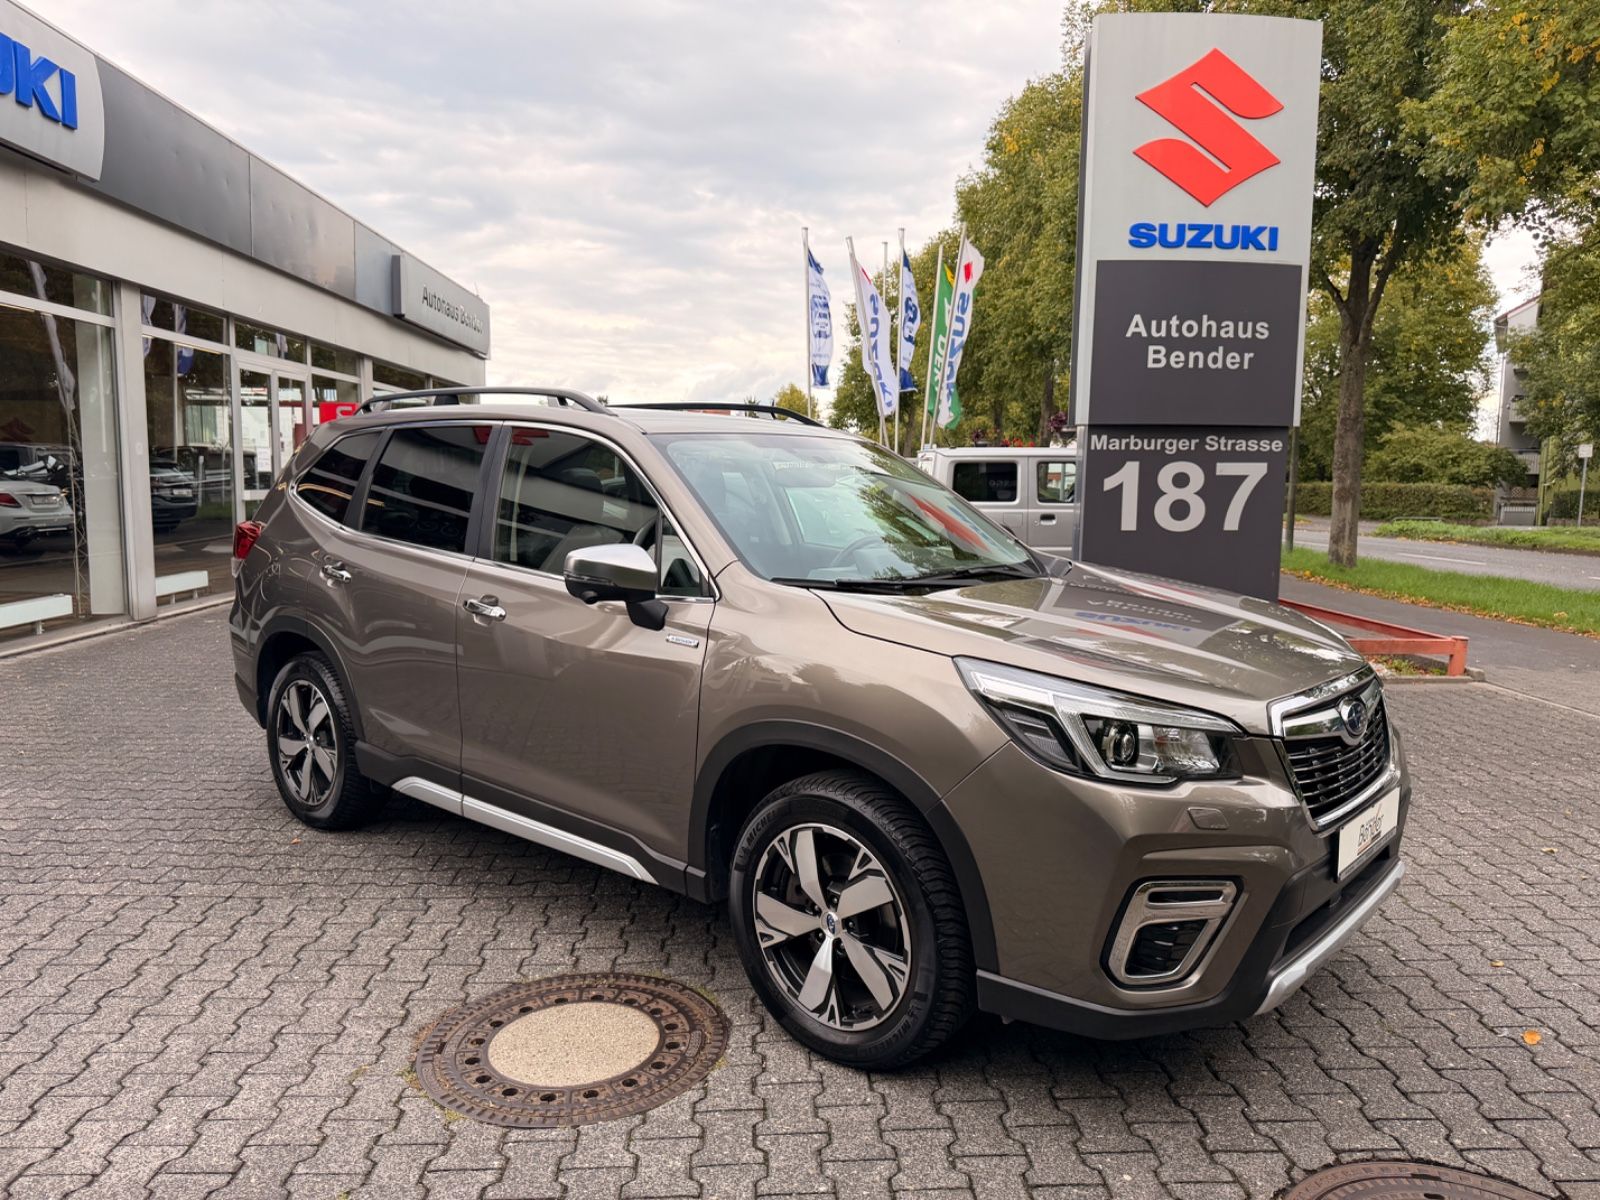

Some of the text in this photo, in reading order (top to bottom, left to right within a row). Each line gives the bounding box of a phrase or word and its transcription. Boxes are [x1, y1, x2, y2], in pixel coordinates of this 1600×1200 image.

[1128, 222, 1279, 251] SUZUKI
[1126, 314, 1270, 340] Autohaus
[946, 292, 970, 402] SUZUK
[1146, 345, 1255, 370] Bender
[1090, 434, 1283, 455] Marburger Strasse
[1103, 460, 1268, 532] 187
